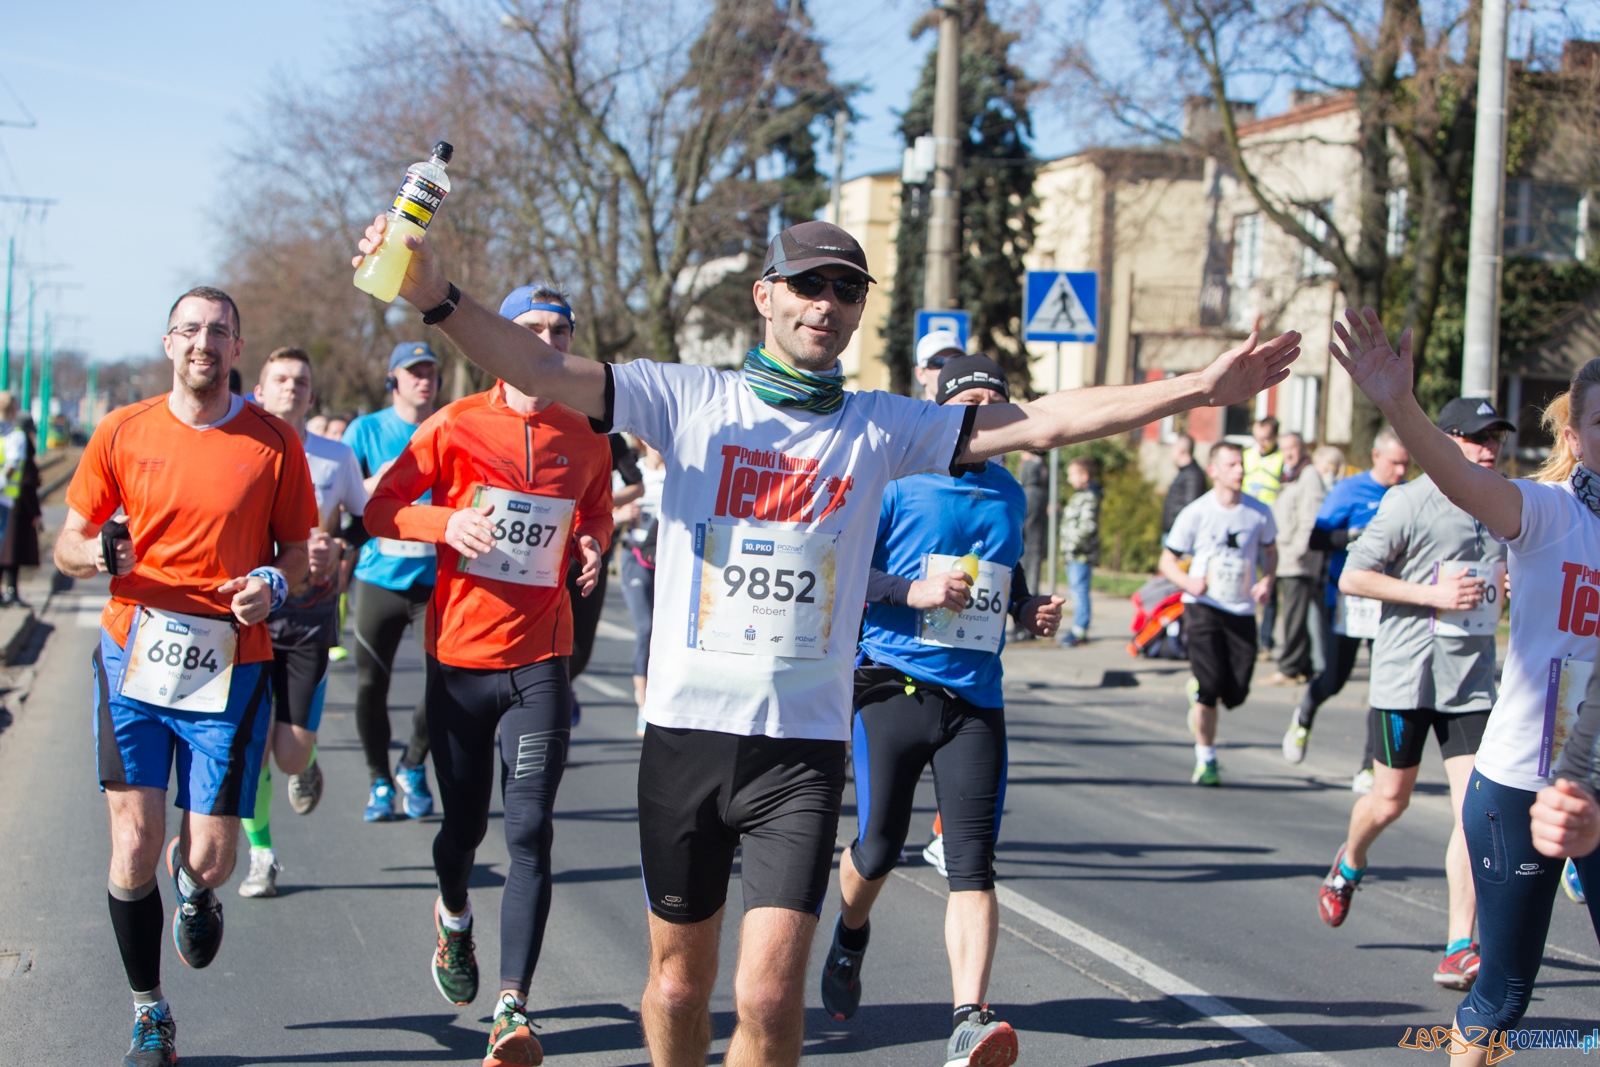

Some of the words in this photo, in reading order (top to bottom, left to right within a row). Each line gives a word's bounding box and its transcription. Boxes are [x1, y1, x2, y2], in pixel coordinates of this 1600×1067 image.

[714, 444, 819, 523] Team
[490, 518, 557, 548] 6887
[512, 548, 531, 556] Karol
[723, 565, 816, 604] 9852
[1558, 561, 1600, 639] Te
[752, 605, 787, 617] Robert
[958, 613, 989, 622] Krzysztof
[147, 639, 218, 673] 6884
